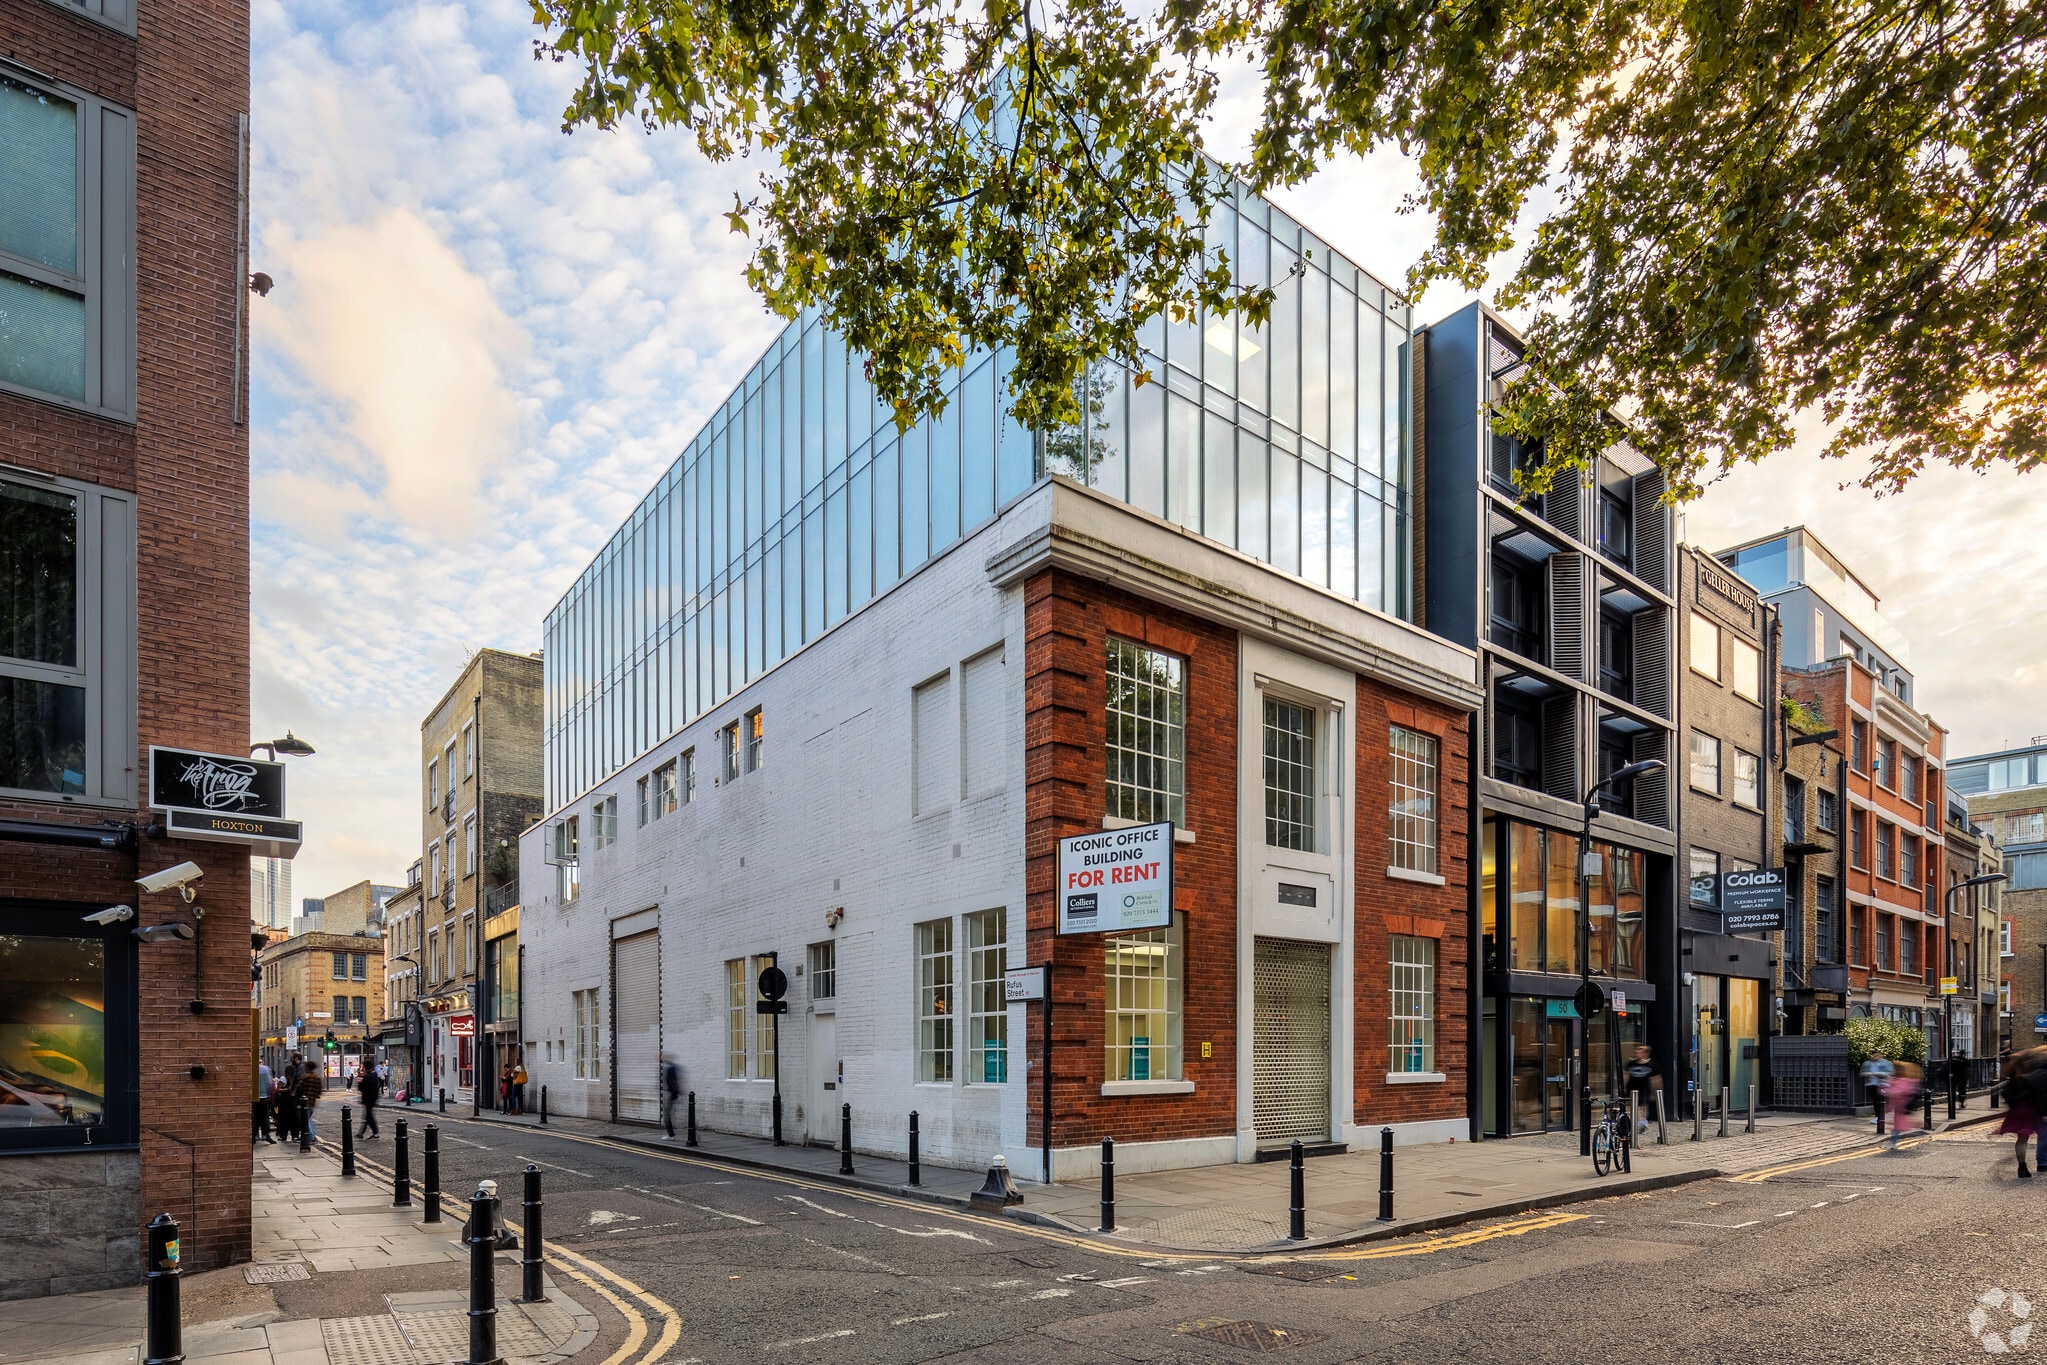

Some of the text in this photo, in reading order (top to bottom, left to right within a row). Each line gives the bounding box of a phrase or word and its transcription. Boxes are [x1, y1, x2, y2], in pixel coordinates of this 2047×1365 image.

[1706, 570, 1754, 614] GELLER HOUSE
[211, 819, 263, 833] HOXTON
[1070, 829, 1158, 852] ICONIC OFFICE
[1084, 848, 1143, 865] BUILDING
[1069, 862, 1160, 889] FOR RENT
[1070, 898, 1095, 906] Colliers
[1743, 914, 1761, 922] 7993
[1761, 913, 1780, 921] 8786
[1730, 921, 1778, 929] colabspaces.co
[1007, 989, 1024, 997] Street
[1558, 1003, 1568, 1014] 50
[1204, 1044, 1210, 1056] H
